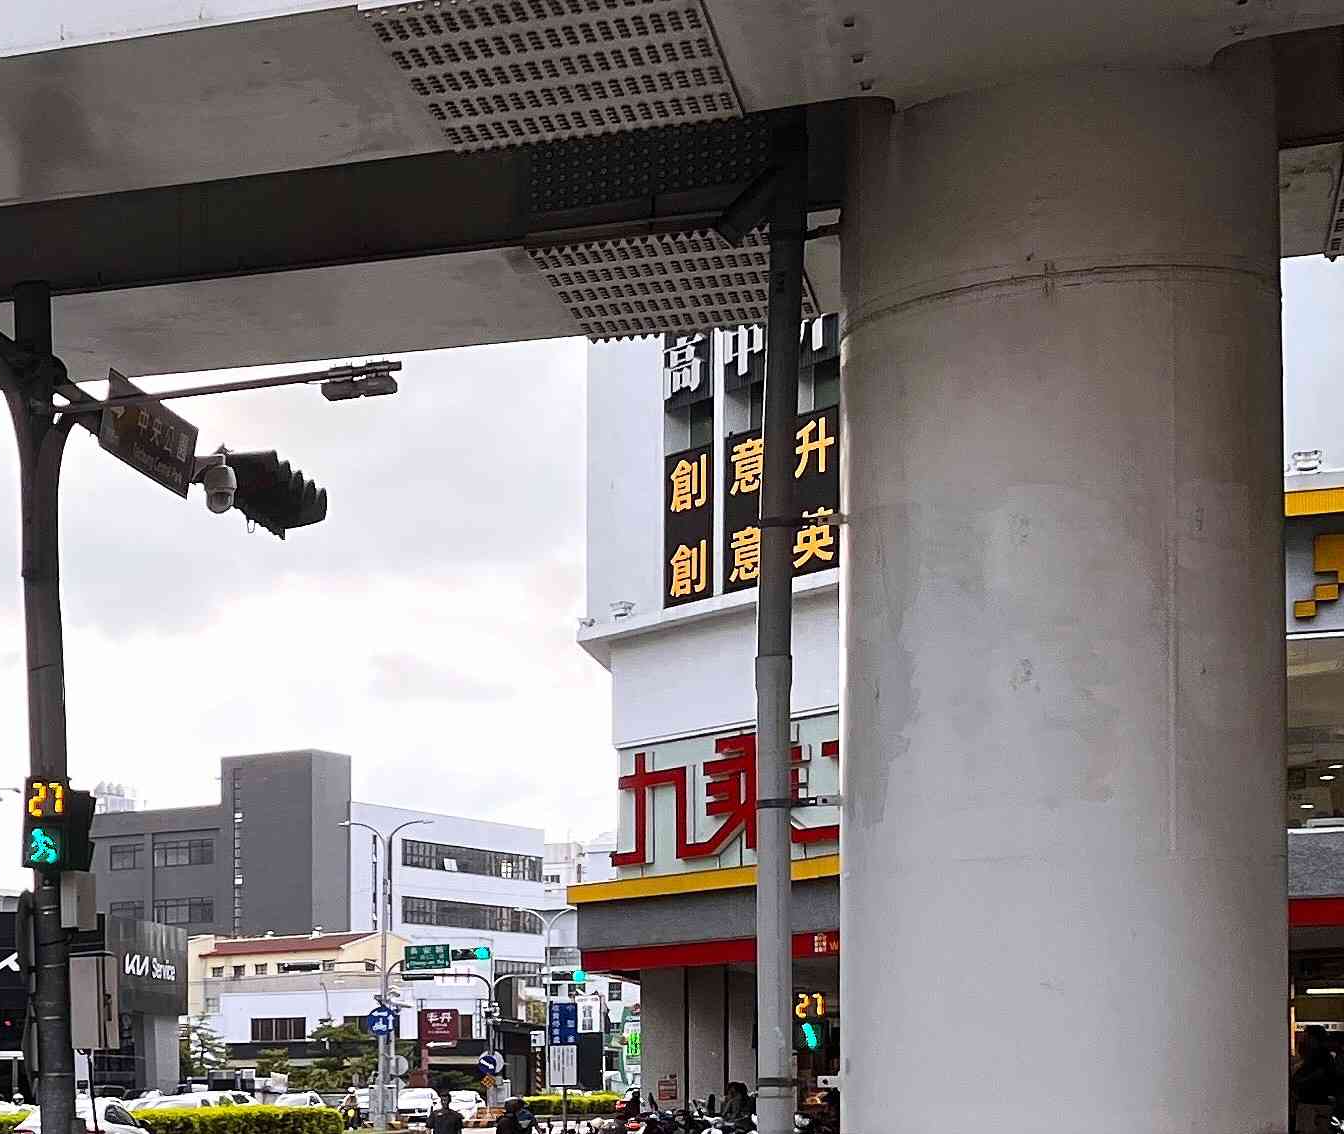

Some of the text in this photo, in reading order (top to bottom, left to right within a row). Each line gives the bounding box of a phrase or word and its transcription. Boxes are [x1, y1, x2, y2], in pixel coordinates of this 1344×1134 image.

[28, 782, 64, 817] 27
[151, 957, 176, 981] Service
[795, 992, 825, 1019] 27
